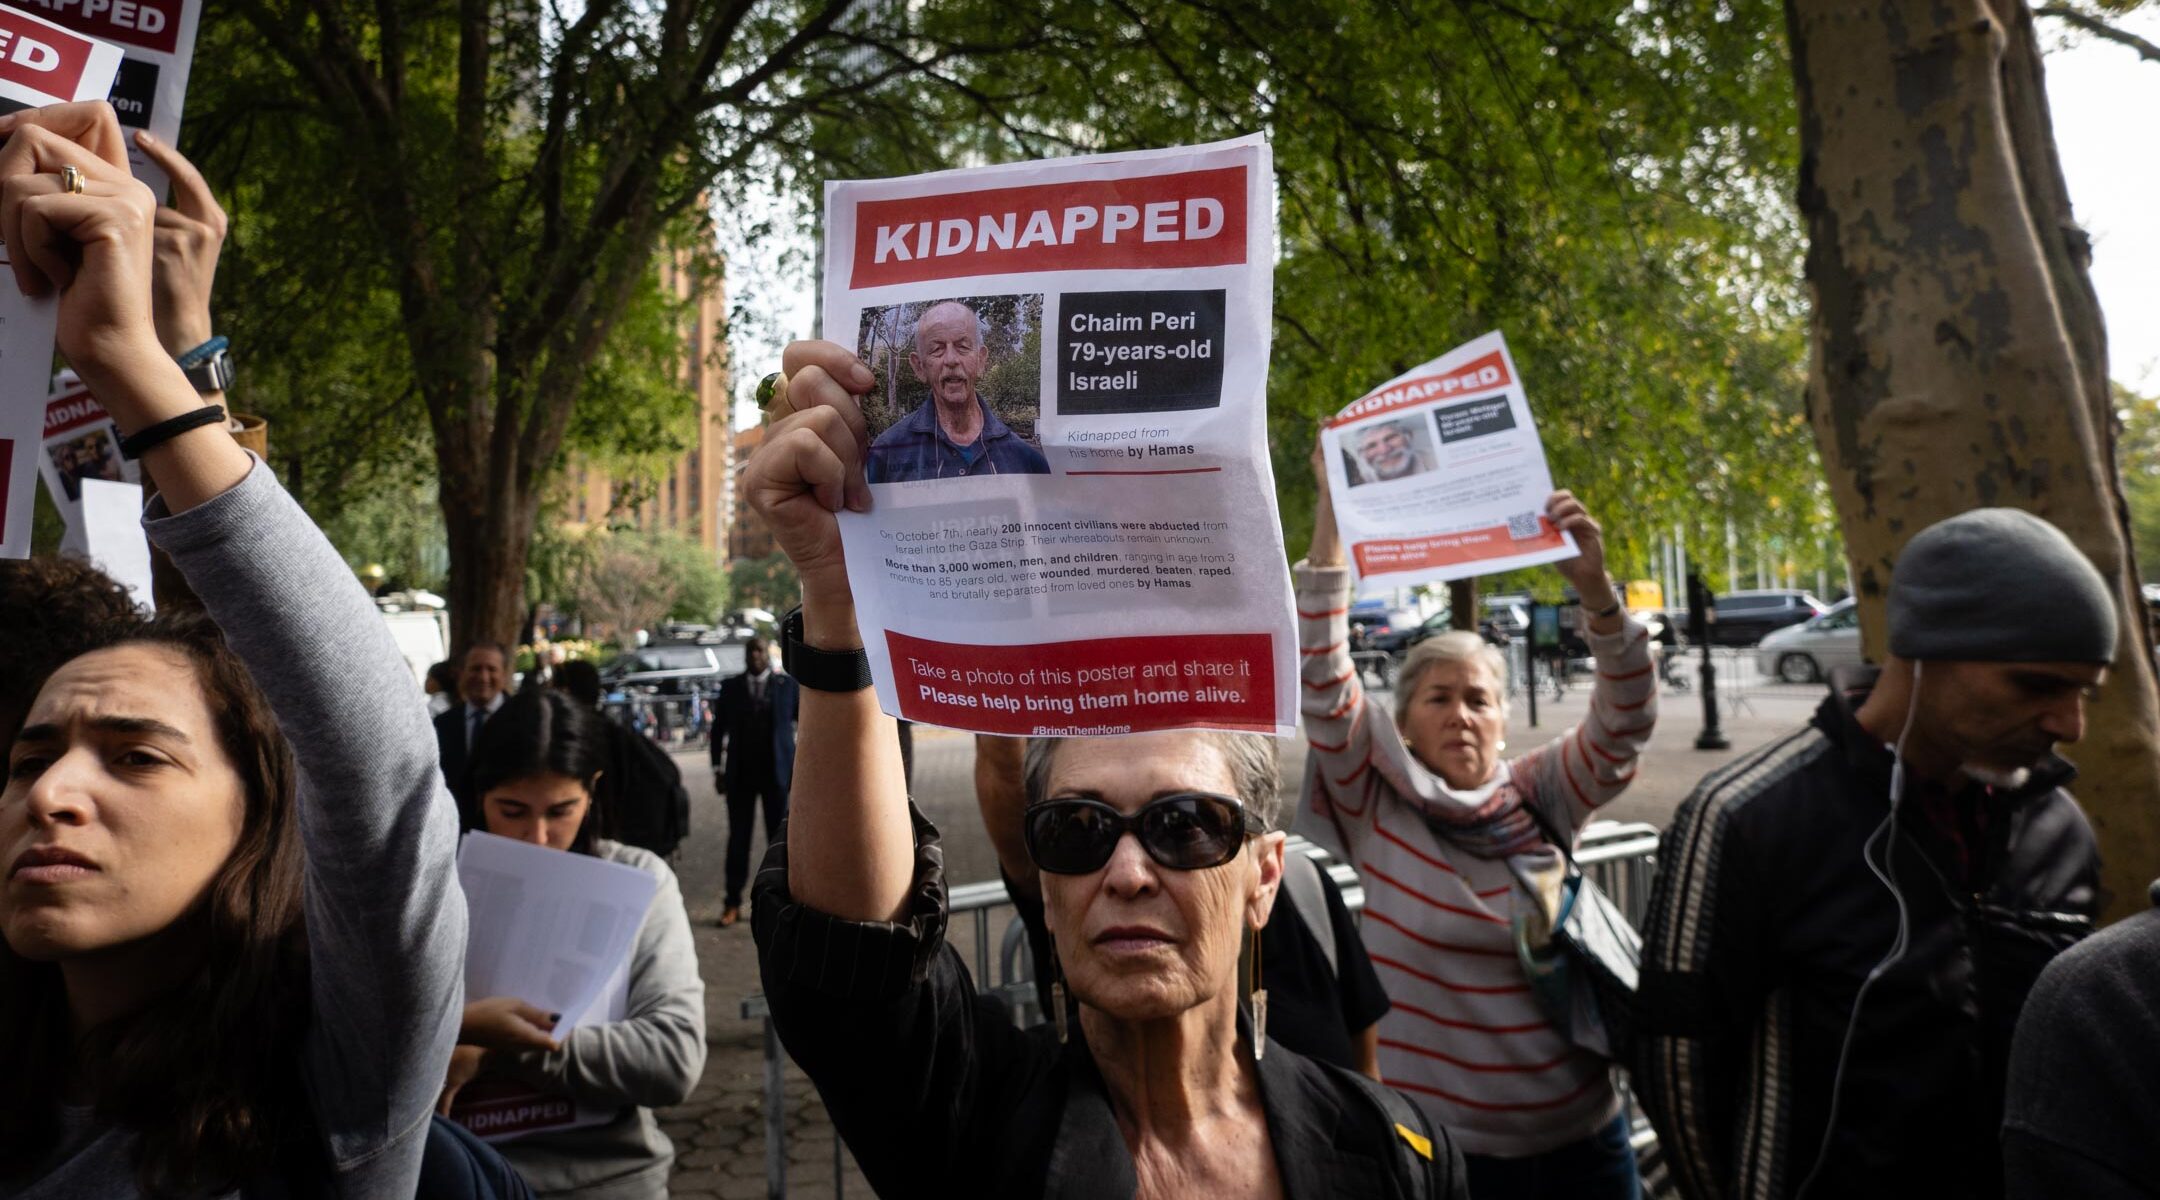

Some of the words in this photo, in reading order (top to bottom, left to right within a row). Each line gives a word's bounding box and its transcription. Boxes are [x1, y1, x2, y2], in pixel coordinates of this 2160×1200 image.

[873, 197, 1225, 264] KIDNAPPED
[1070, 313, 1143, 332] Chaim
[1151, 311, 1195, 330] Peri
[1069, 339, 1211, 366] 79-years-old
[1069, 370, 1138, 391] Israeli
[1067, 428, 1137, 443] Kidnapped
[1141, 427, 1170, 439] from
[1069, 448, 1087, 459] his
[1091, 449, 1124, 459] home
[1128, 446, 1144, 460] by
[1148, 444, 1195, 457] Hamas
[879, 529, 893, 540] On
[896, 531, 940, 542] October
[966, 525, 998, 538] nearly
[1001, 523, 1022, 534] 200
[1024, 521, 1071, 532] innocent
[1074, 520, 1118, 531] civilians
[1120, 522, 1146, 531] were
[1149, 522, 1200, 531] abducted
[1202, 521, 1228, 531] from
[895, 545, 924, 555] Israel
[926, 545, 946, 555] into
[949, 543, 965, 553] the
[969, 540, 997, 552] Gaza
[1031, 535, 1056, 546] Their
[1060, 533, 1125, 544] whereabouts
[1127, 533, 1161, 543] remain
[1164, 534, 1214, 545] unknown.
[885, 558, 909, 572] More
[912, 564, 936, 574] than
[938, 562, 969, 575] 3,000
[972, 559, 1017, 573] women,
[1019, 556, 1047, 568] men,
[1050, 553, 1071, 564] and
[1124, 553, 1164, 564] ranging
[1165, 552, 1175, 562] in
[1178, 554, 1198, 564] age
[1199, 553, 1225, 563] from
[1227, 552, 1236, 562] 3
[889, 571, 924, 586] months
[926, 577, 936, 587] to
[939, 576, 951, 587] 85
[955, 575, 985, 588] years
[1010, 572, 1037, 582] were
[1199, 566, 1235, 577] raped,
[929, 590, 949, 600] and
[952, 589, 990, 601] brutally
[993, 584, 1048, 599] separated
[1050, 582, 1075, 593] from
[1077, 580, 1106, 591] loved
[1109, 579, 1135, 589] ones
[1137, 578, 1151, 590] by
[908, 657, 946, 680] Take
[951, 669, 962, 682] a
[966, 668, 1014, 686] photo
[1019, 669, 1034, 685] of
[1040, 668, 1072, 685] this
[1077, 665, 1136, 687] poster
[1142, 660, 1177, 678] and
[1183, 659, 1234, 677] share
[1239, 659, 1251, 677] it
[919, 685, 978, 708] Please
[981, 693, 1021, 713] help
[1025, 695, 1074, 714] bring
[1079, 693, 1128, 710] them
[1134, 688, 1189, 705] home
[1195, 686, 1246, 704] alive.
[1032, 724, 1131, 736] #BringThemHome
[464, 1102, 569, 1130] IDNAPPED
